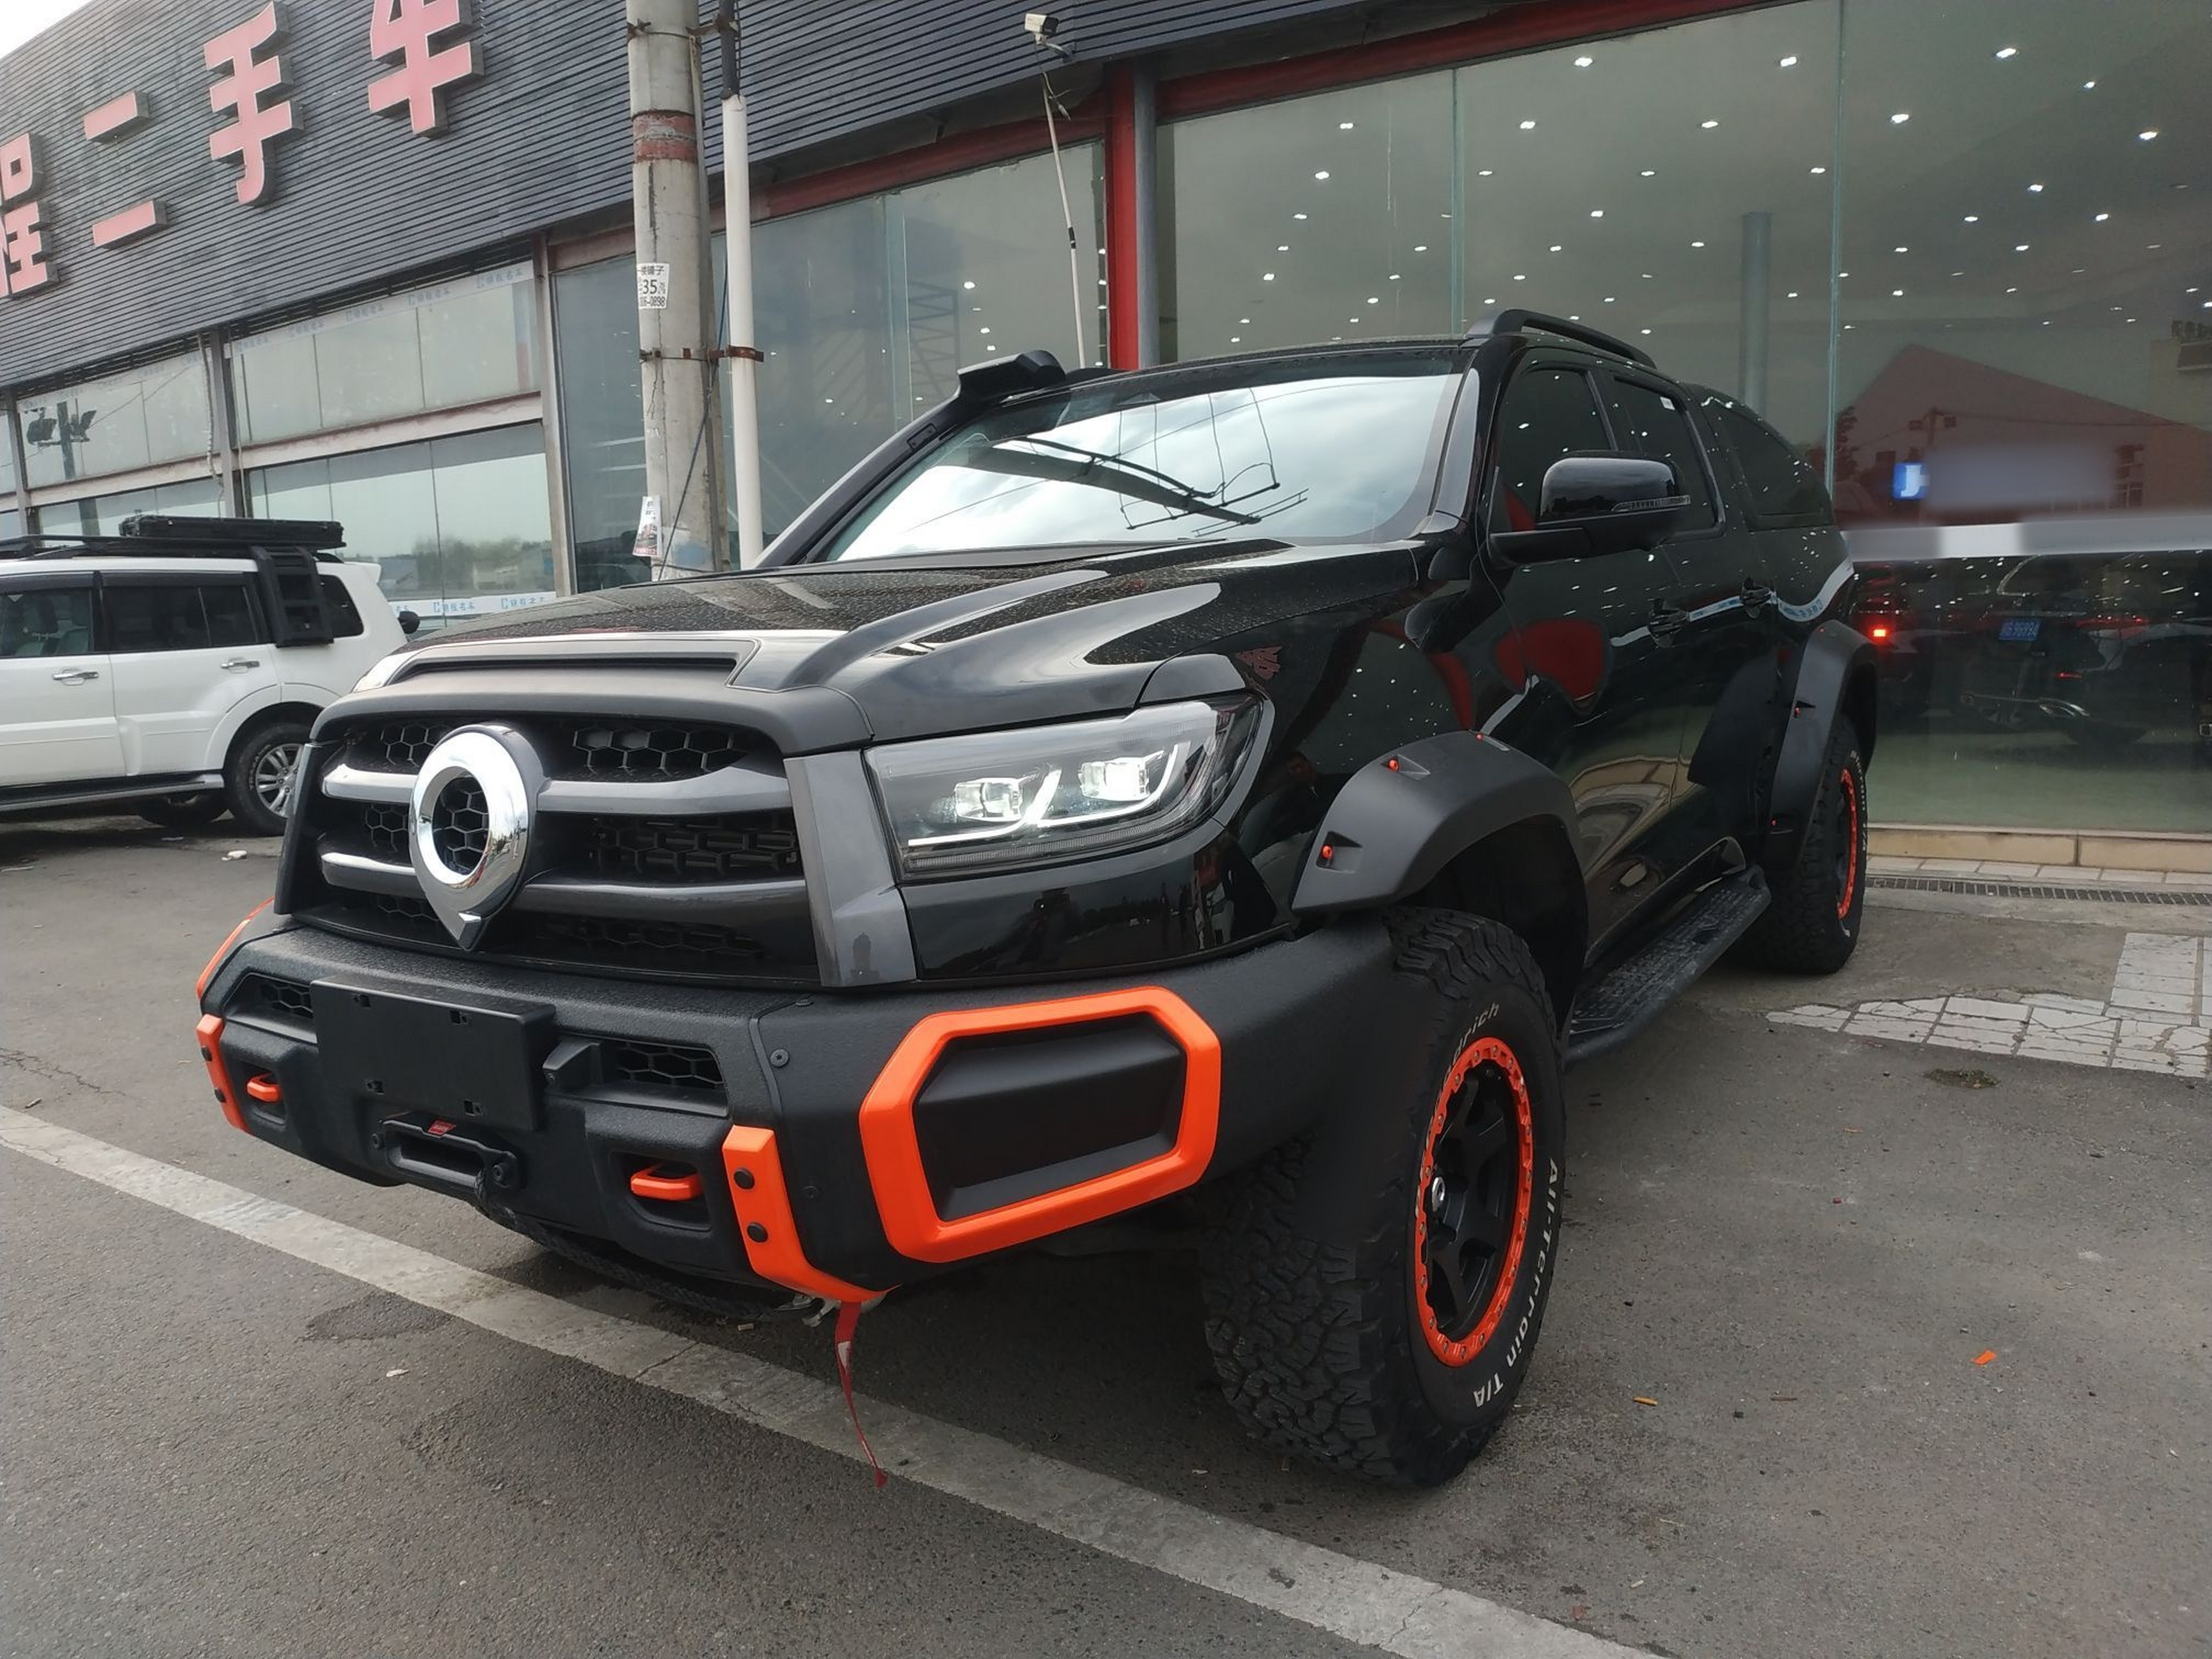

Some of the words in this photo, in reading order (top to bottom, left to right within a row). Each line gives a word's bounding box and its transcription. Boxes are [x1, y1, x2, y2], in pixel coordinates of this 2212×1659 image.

[643, 279, 657, 294] 35
[1506, 1157, 1558, 1368] All-Terrain
[1473, 1372, 1504, 1408] T/A
